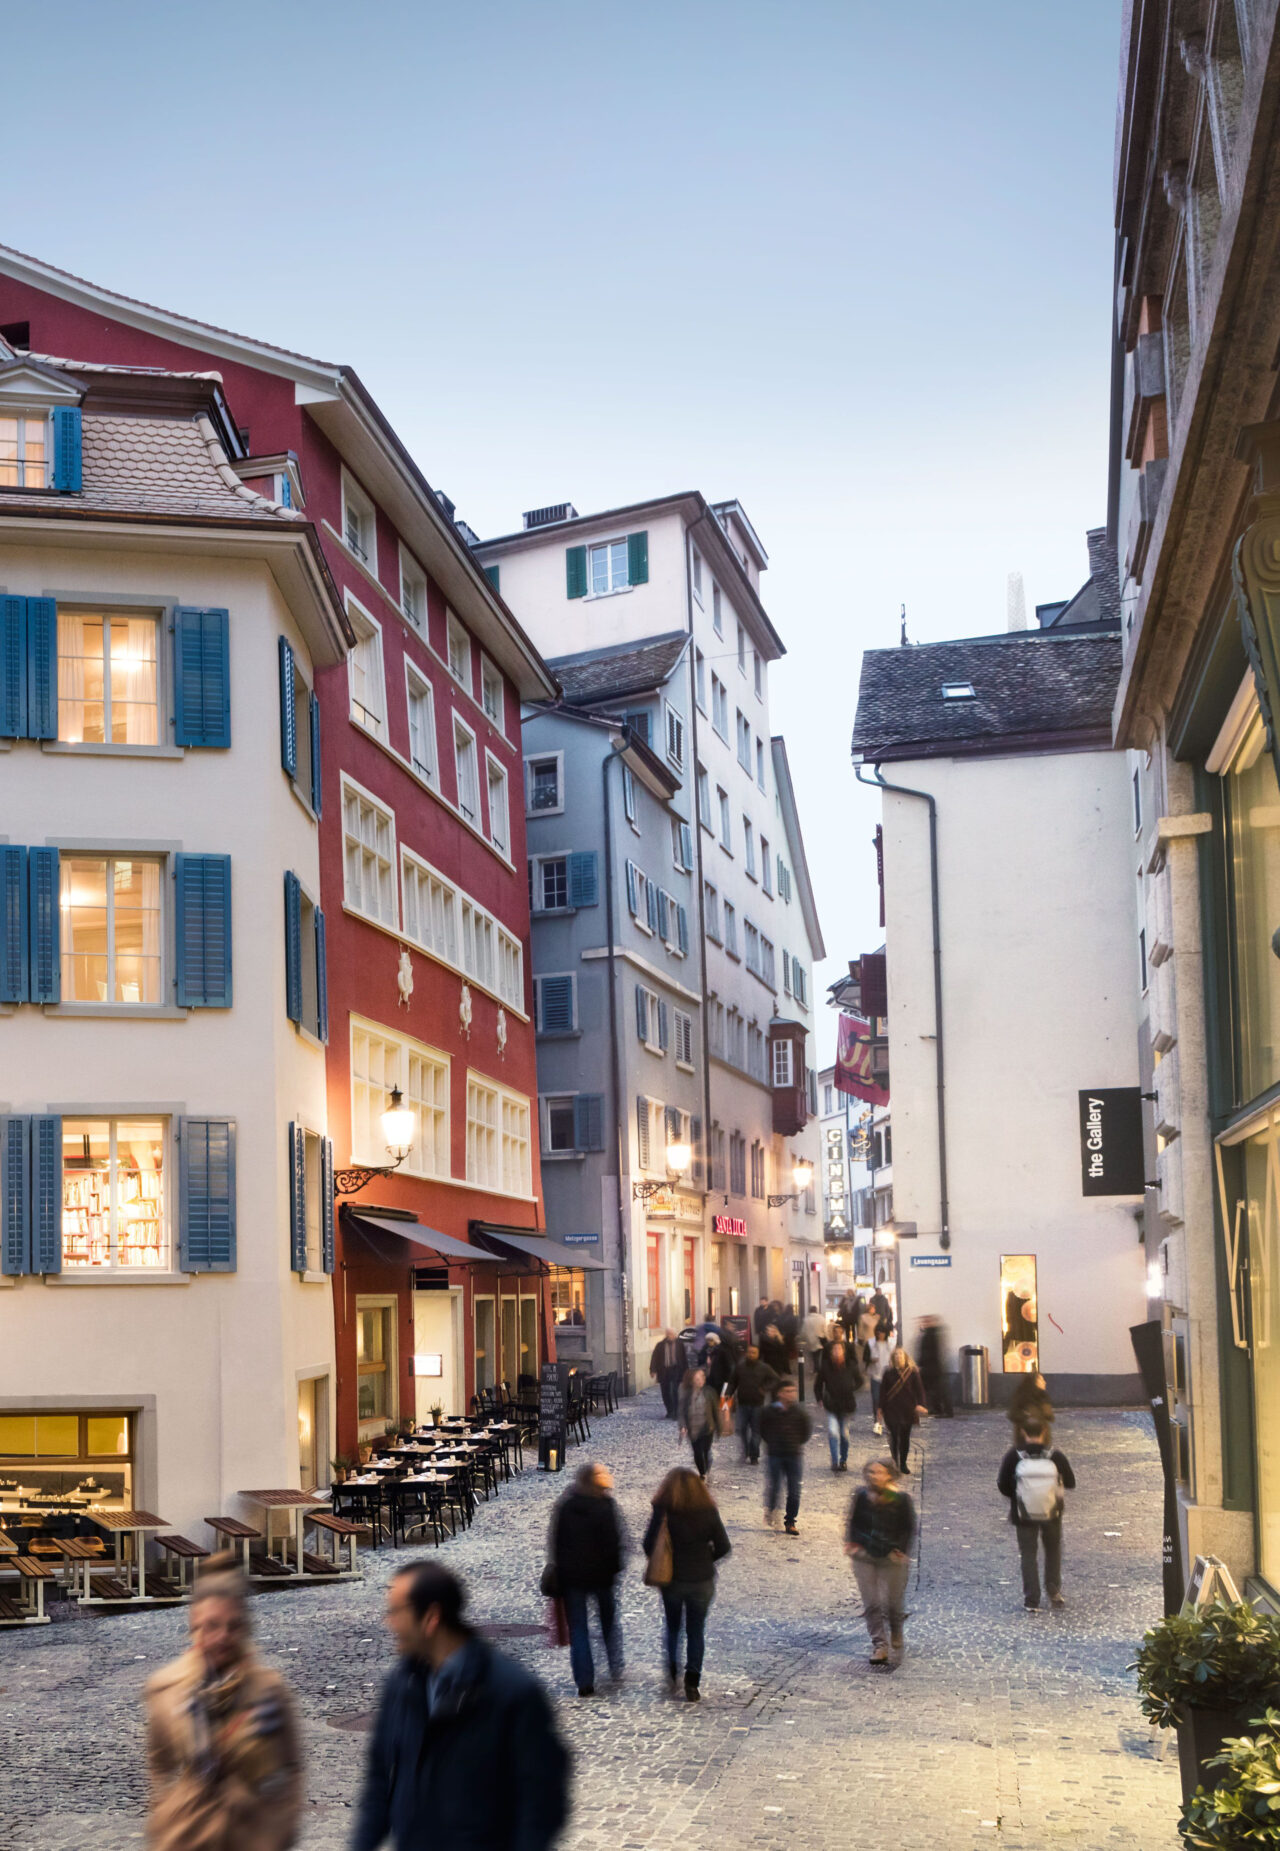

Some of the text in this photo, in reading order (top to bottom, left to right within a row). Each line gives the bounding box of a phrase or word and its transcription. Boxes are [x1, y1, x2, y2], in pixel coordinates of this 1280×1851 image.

[1086, 1097, 1104, 1178] the Gallery
[827, 1129, 846, 1229] CINEMA
[716, 1215, 747, 1237] SANTA LUCIA
